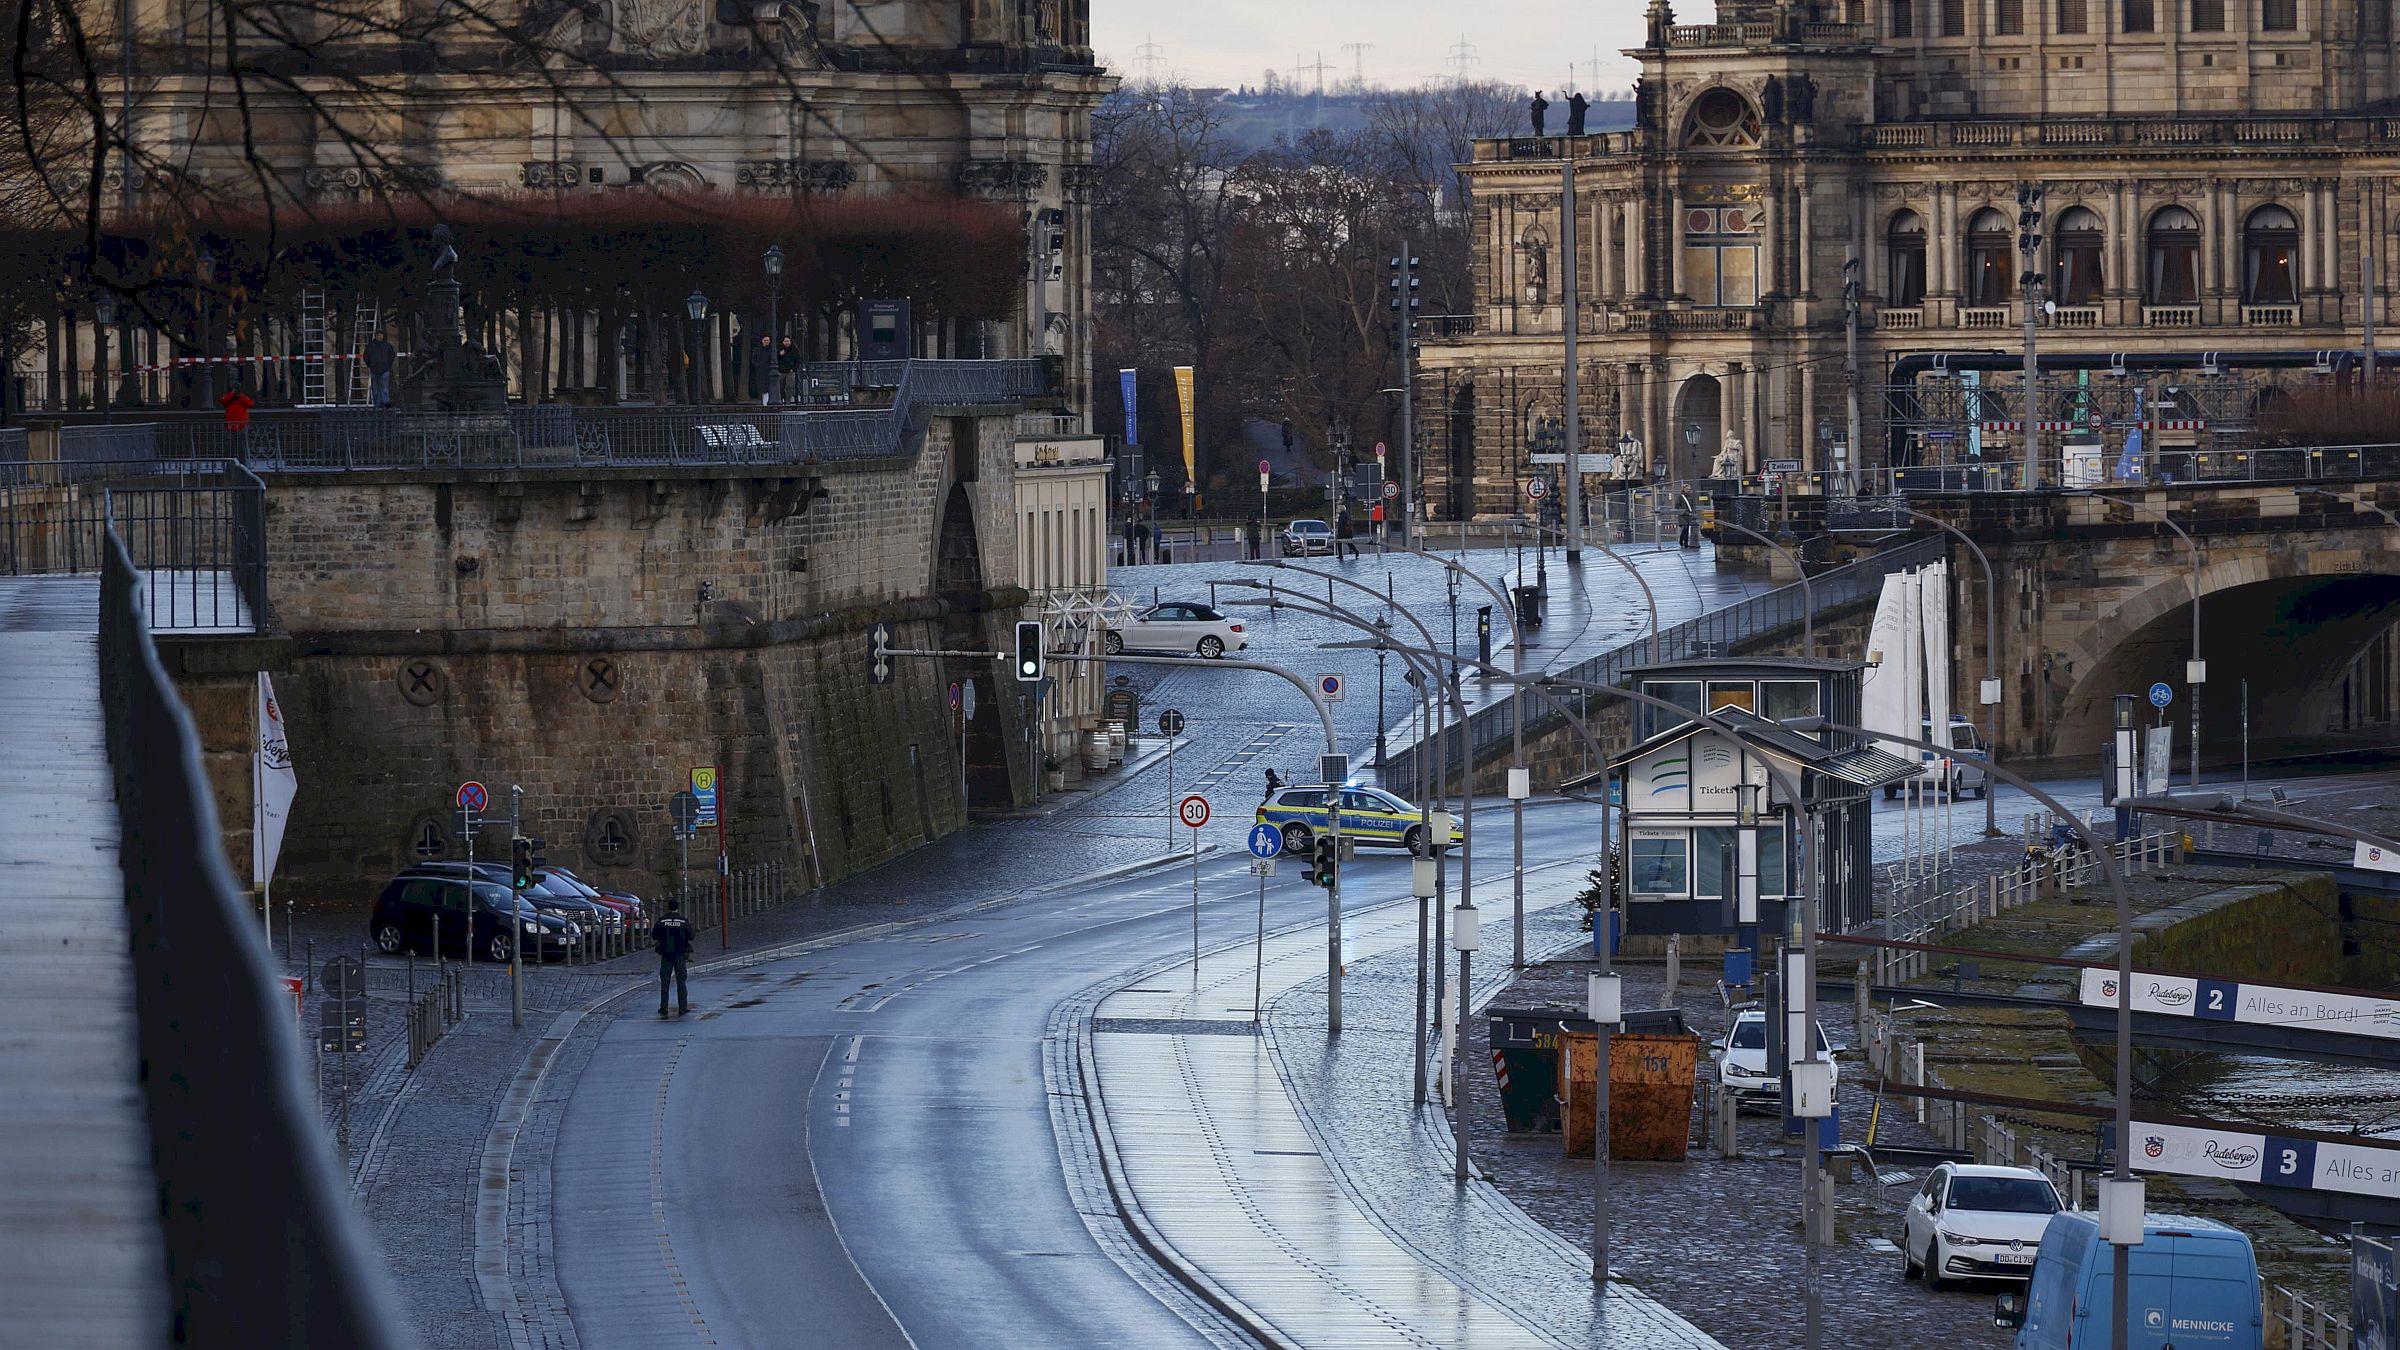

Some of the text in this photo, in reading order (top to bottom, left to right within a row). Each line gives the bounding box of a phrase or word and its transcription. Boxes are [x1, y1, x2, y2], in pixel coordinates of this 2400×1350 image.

[1385, 486, 1396, 494] 30
[699, 775, 708, 786] H
[1699, 786, 1735, 795] Tickets
[1186, 804, 1204, 819] 30
[1361, 818, 1394, 829] POLIZEI
[2148, 982, 2190, 1002] Radeberger
[2208, 989, 2224, 1011] 2
[2246, 997, 2359, 1022] Alles an Bord!
[2202, 1140, 2257, 1165] Radeberger
[2280, 1149, 2298, 1175] 3
[2326, 1159, 2373, 1181] Alles
[2172, 1319, 2235, 1332] MENNICKE
